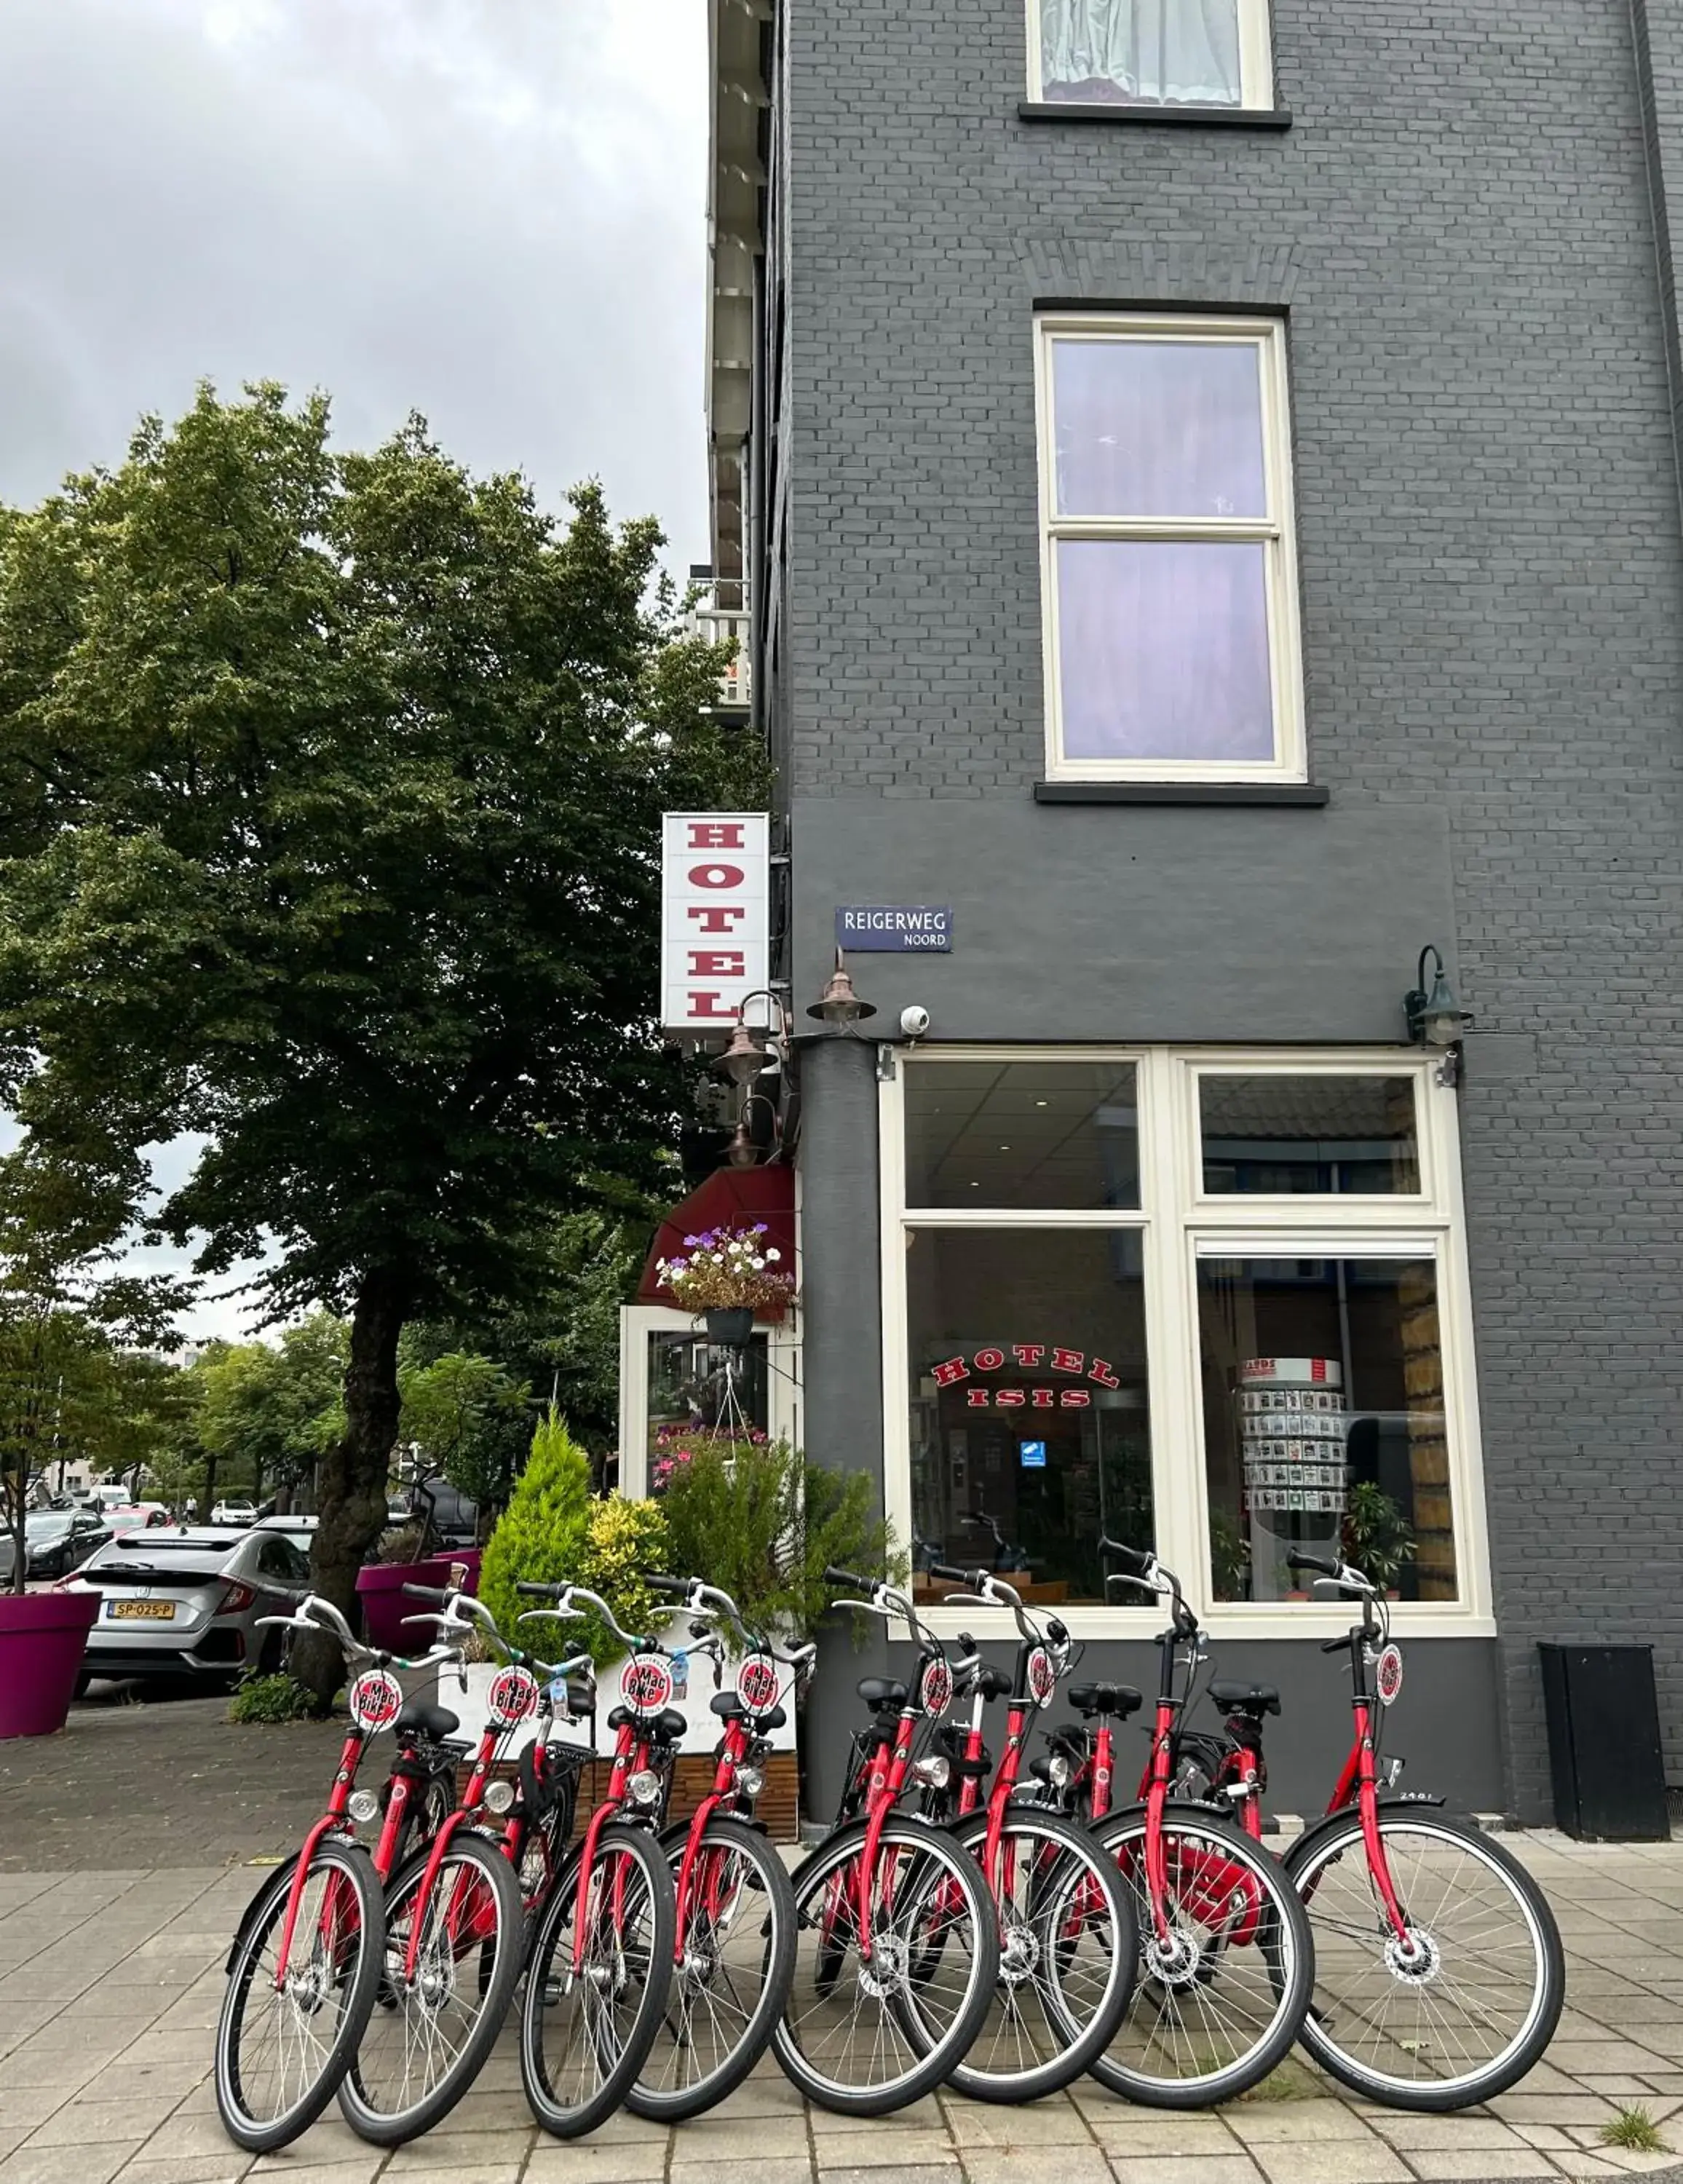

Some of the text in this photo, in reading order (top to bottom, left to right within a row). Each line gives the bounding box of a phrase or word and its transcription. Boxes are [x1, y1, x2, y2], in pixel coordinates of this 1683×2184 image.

[686, 823, 745, 1018] HOTEL
[844, 911, 946, 930] REIGERWEG
[904, 934, 946, 946] NOORD
[931, 1345, 1120, 1389] HOTEL
[967, 1389, 1090, 1407] ISIS
[117, 1604, 170, 1615] SP-025-P
